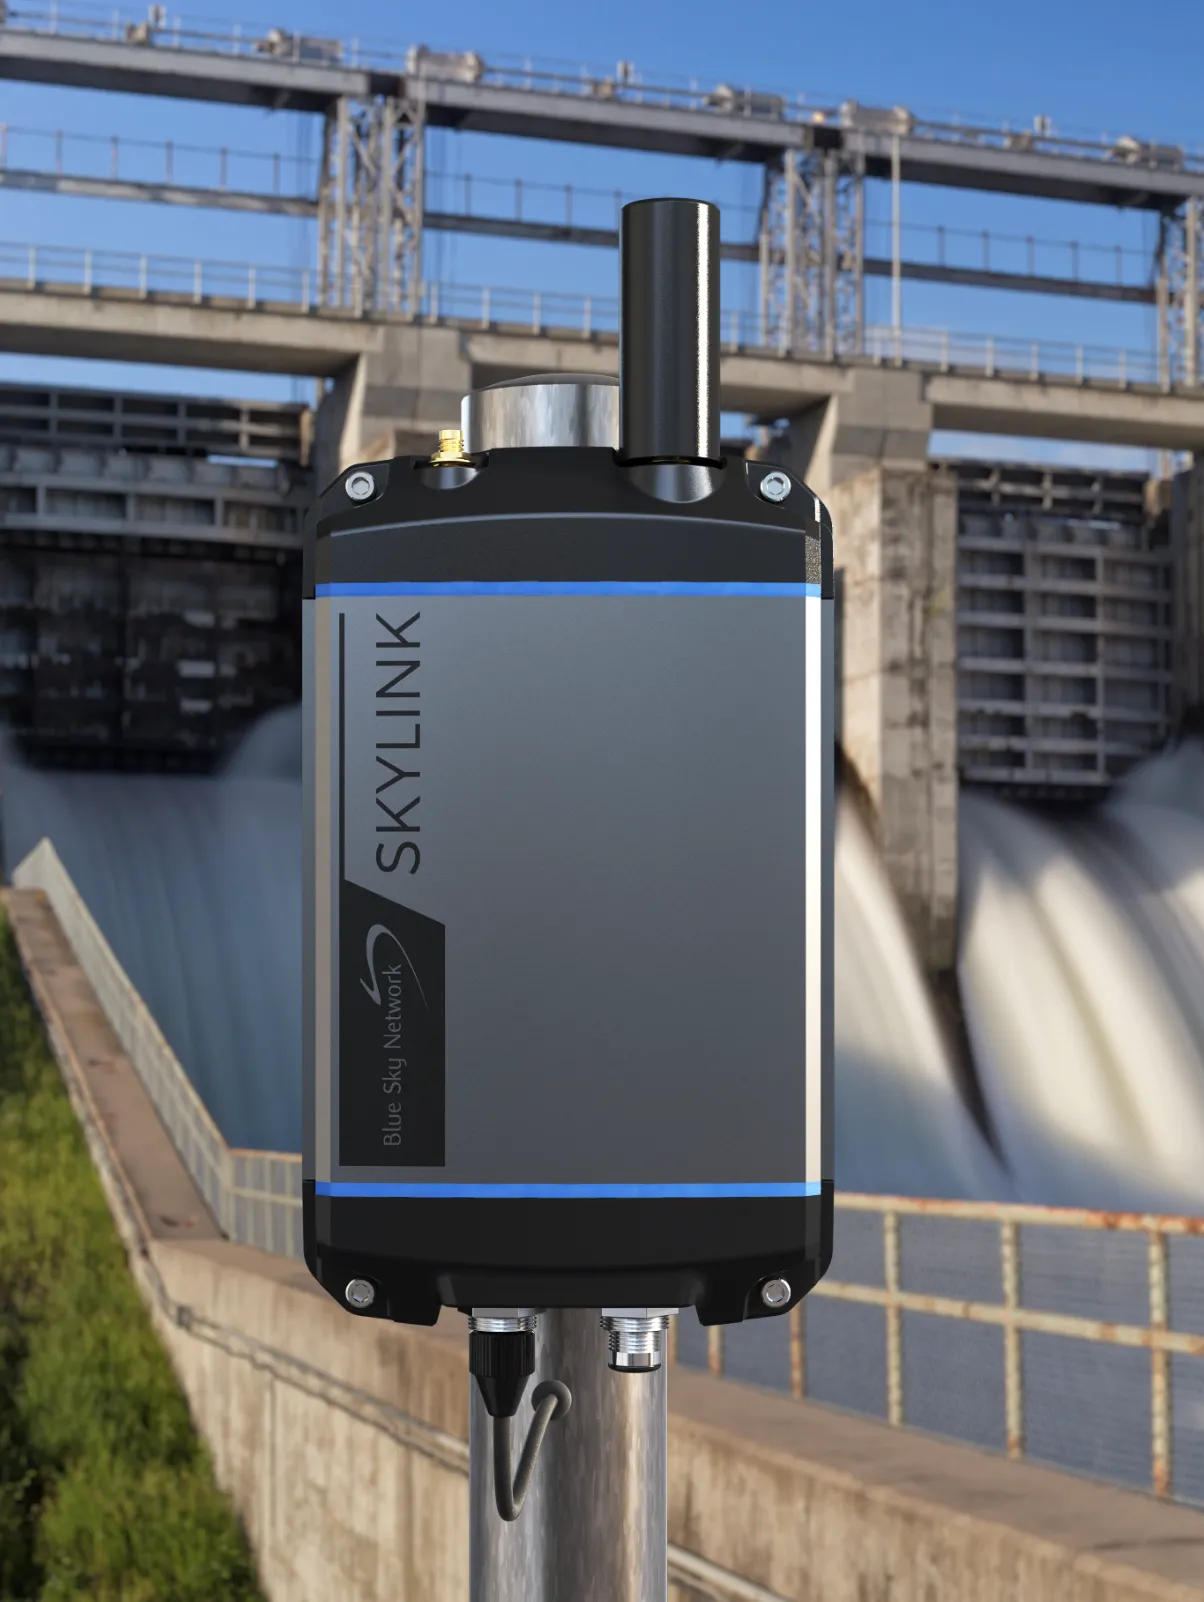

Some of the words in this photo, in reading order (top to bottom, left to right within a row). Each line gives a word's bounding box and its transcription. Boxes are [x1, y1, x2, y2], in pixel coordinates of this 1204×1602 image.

[375, 611, 421, 875] SKYLINK
[382, 963, 402, 1049] Network
[382, 1057, 408, 1094] Sky
[382, 1102, 402, 1146] Blue
